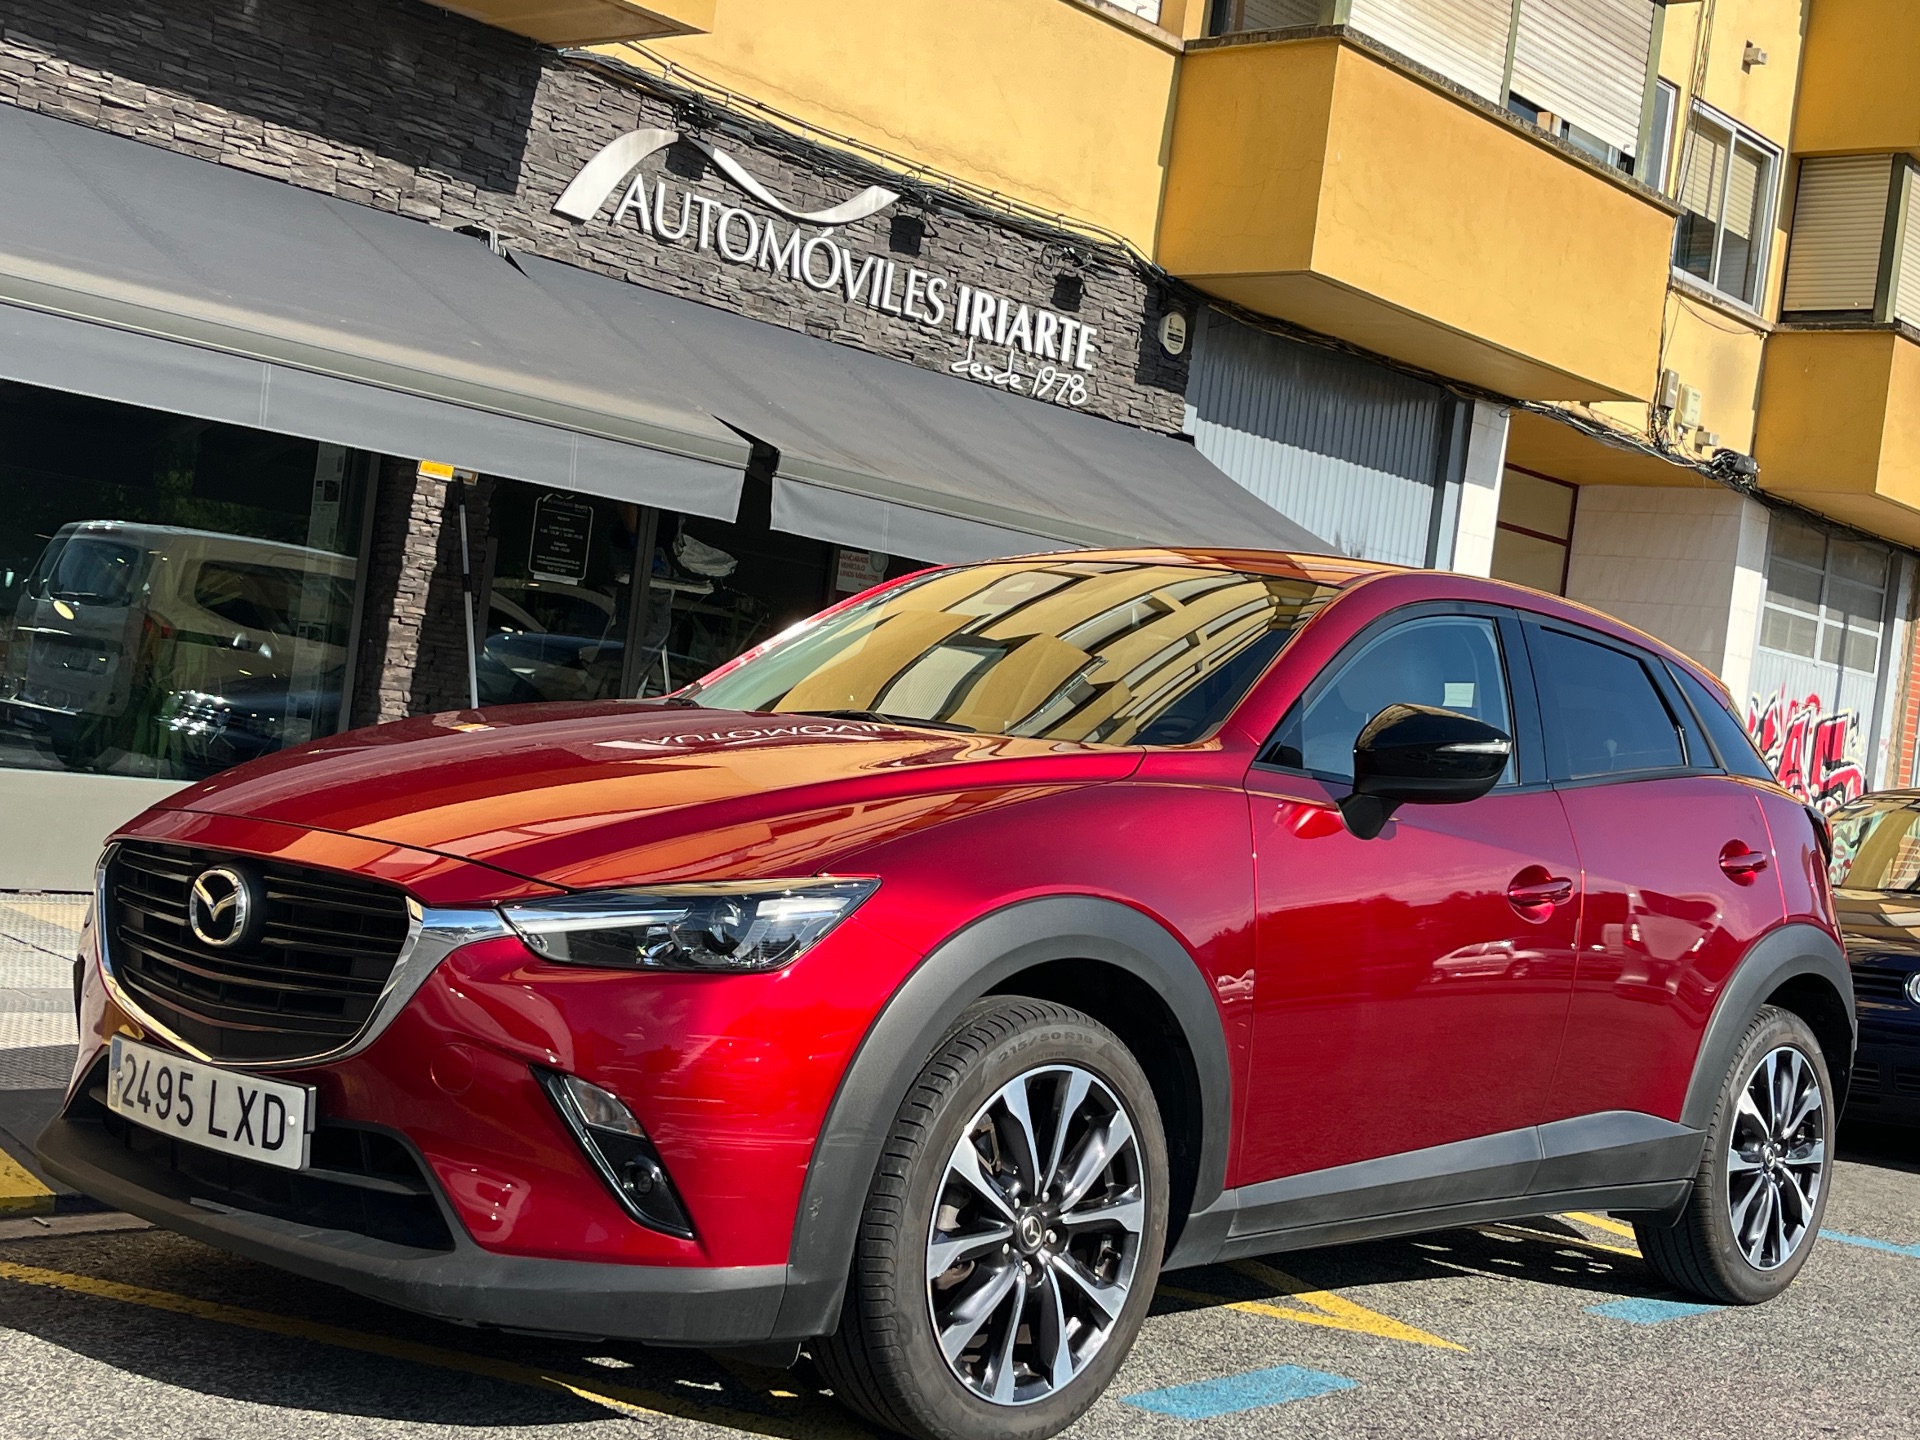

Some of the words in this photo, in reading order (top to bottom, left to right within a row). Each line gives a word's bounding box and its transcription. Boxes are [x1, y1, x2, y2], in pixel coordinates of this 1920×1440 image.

[615, 174, 946, 325] AUTOMÓVILES
[956, 286, 1096, 369] IRIARTE
[951, 337, 1021, 391] desde
[1032, 368, 1087, 405] 1978
[122, 1053, 193, 1126] 2495
[208, 1080, 286, 1150] LXD
